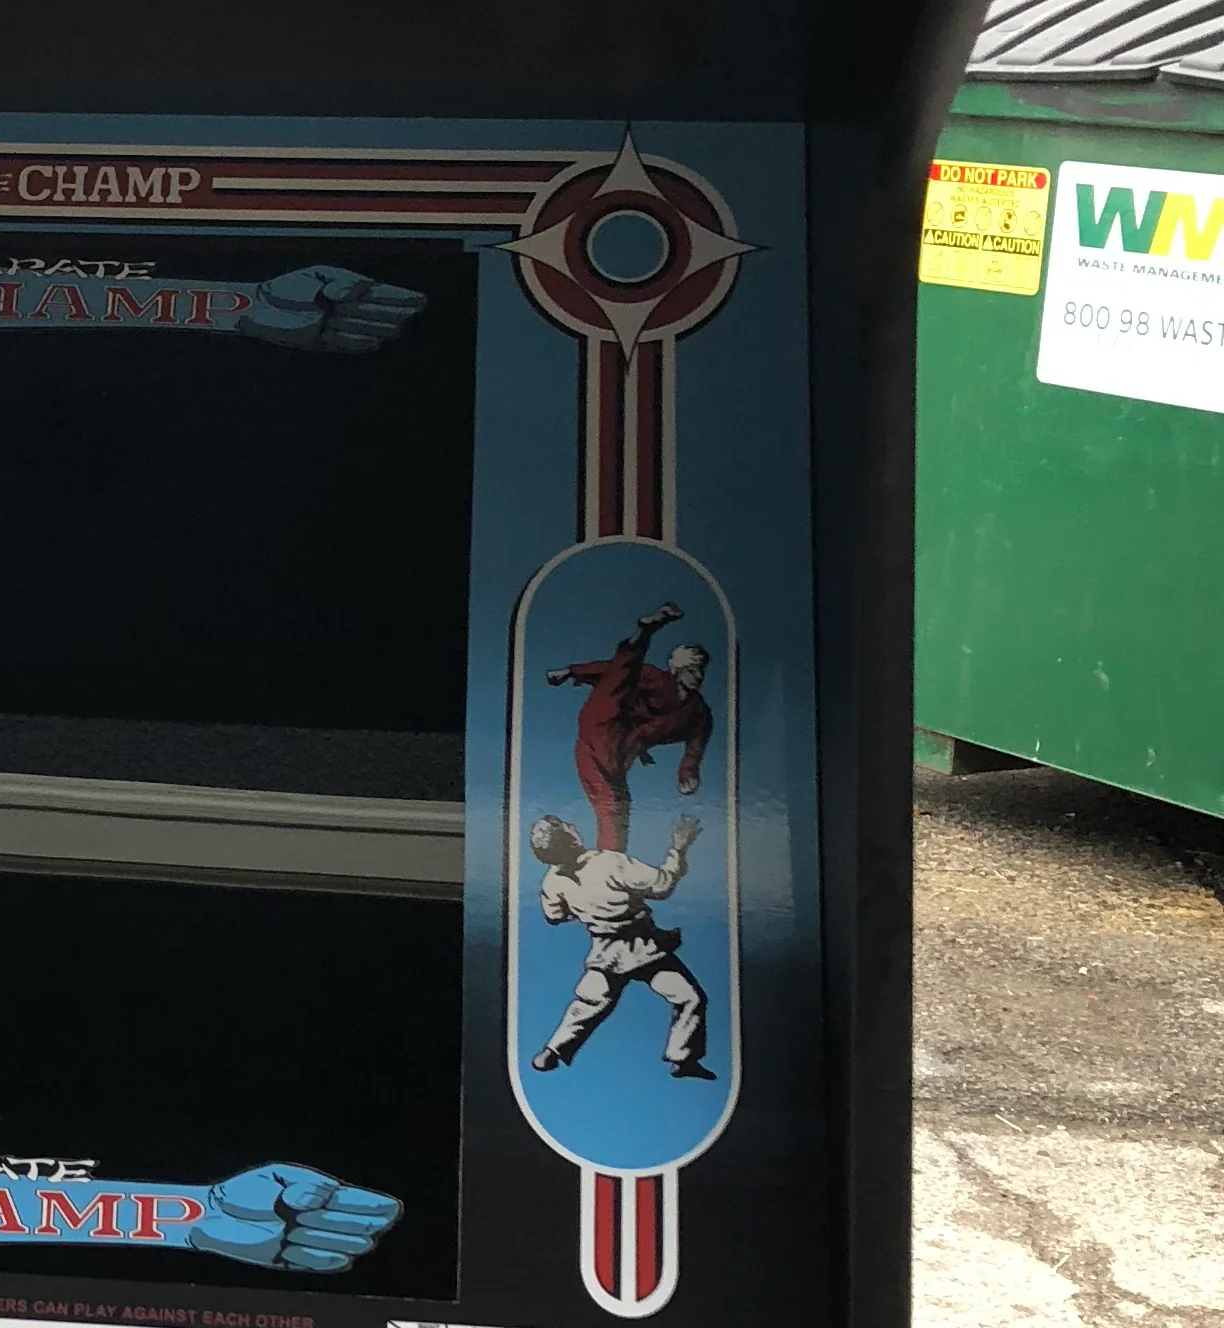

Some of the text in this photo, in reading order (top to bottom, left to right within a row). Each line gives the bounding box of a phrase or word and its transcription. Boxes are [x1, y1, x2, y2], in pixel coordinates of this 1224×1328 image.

[18, 165, 201, 204] CHAMP
[940, 165, 1039, 188] DO NOT PARK
[934, 230, 1040, 255] CAUTION CAUTION
[1078, 258, 1126, 272] WASTE
[1064, 301, 1111, 330] 800
[1119, 308, 1150, 336] 98
[33, 1302, 69, 1316] CAN
[74, 1304, 116, 1318] PLAY
[121, 1306, 197, 1322] AGAINST
[202, 1311, 250, 1326] EACH
